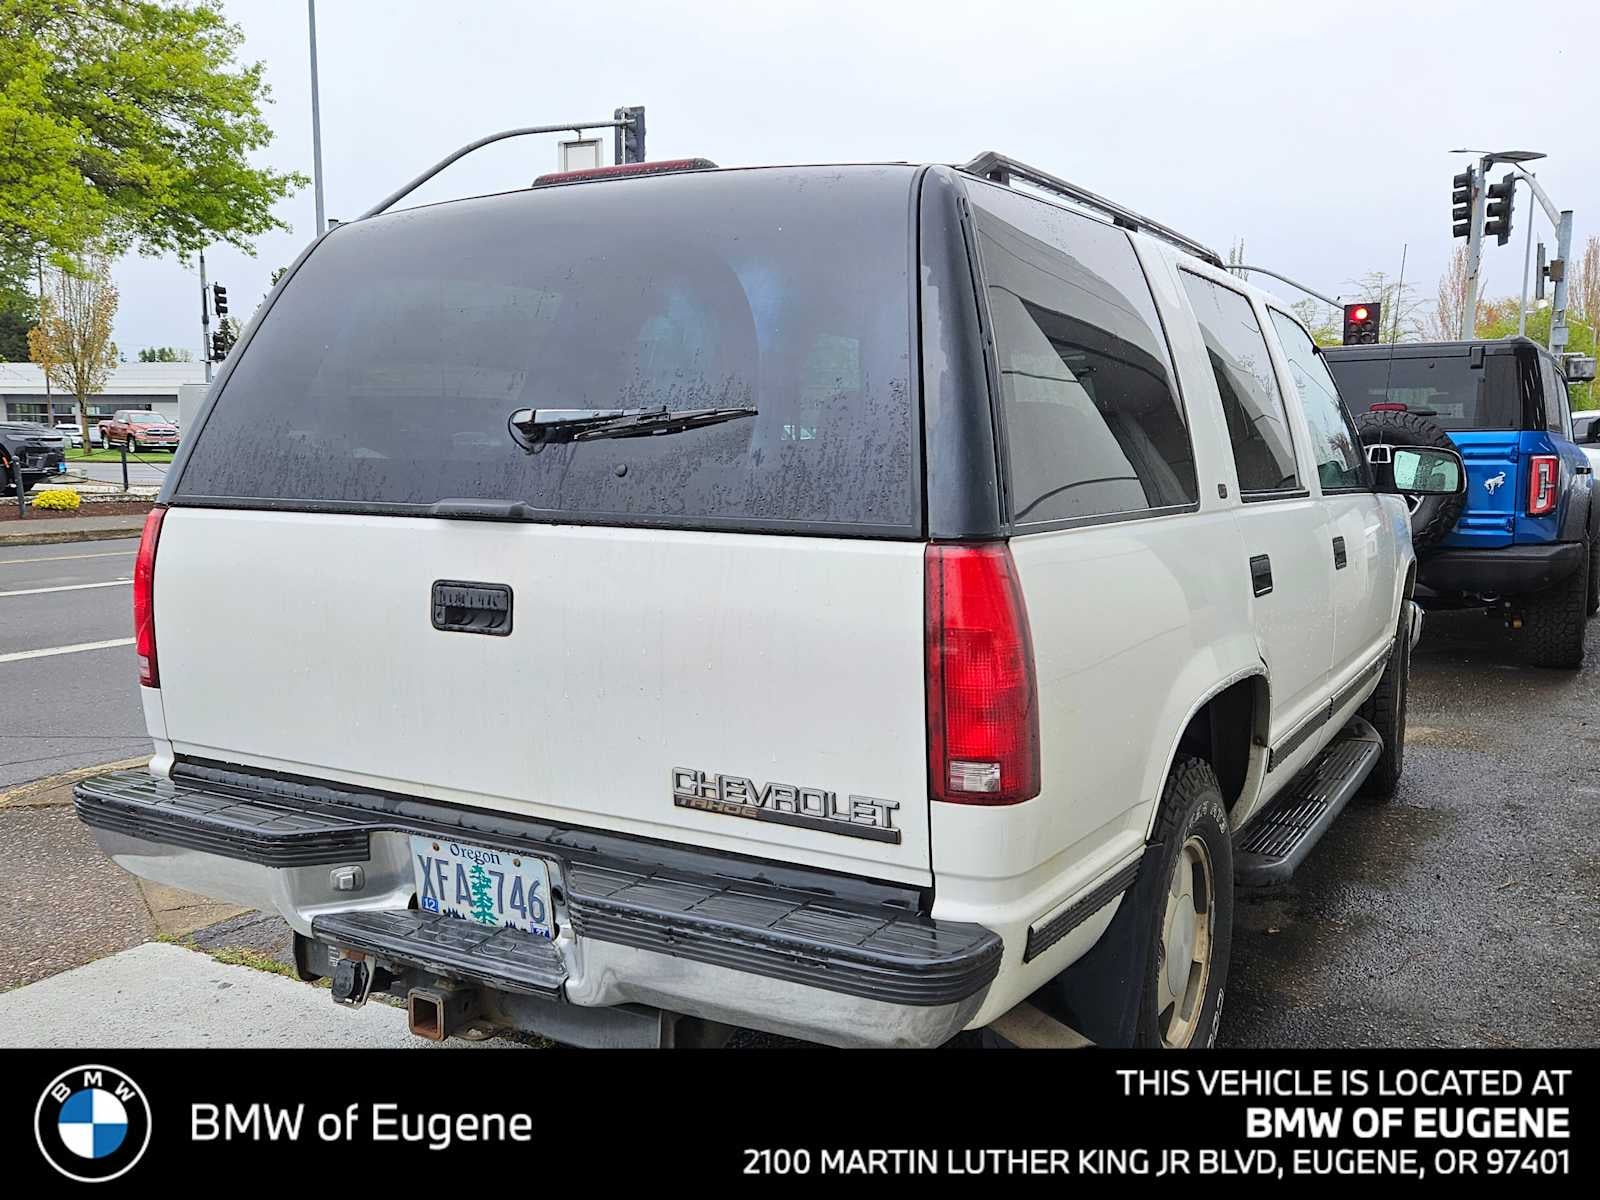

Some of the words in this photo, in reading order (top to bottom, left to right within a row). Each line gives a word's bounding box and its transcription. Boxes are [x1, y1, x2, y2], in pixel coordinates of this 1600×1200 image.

[672, 767, 900, 829] CHEVROLET
[450, 843, 501, 865] Oregon
[417, 854, 474, 907] XFA
[488, 869, 546, 924] 746
[424, 897, 437, 910] 12
